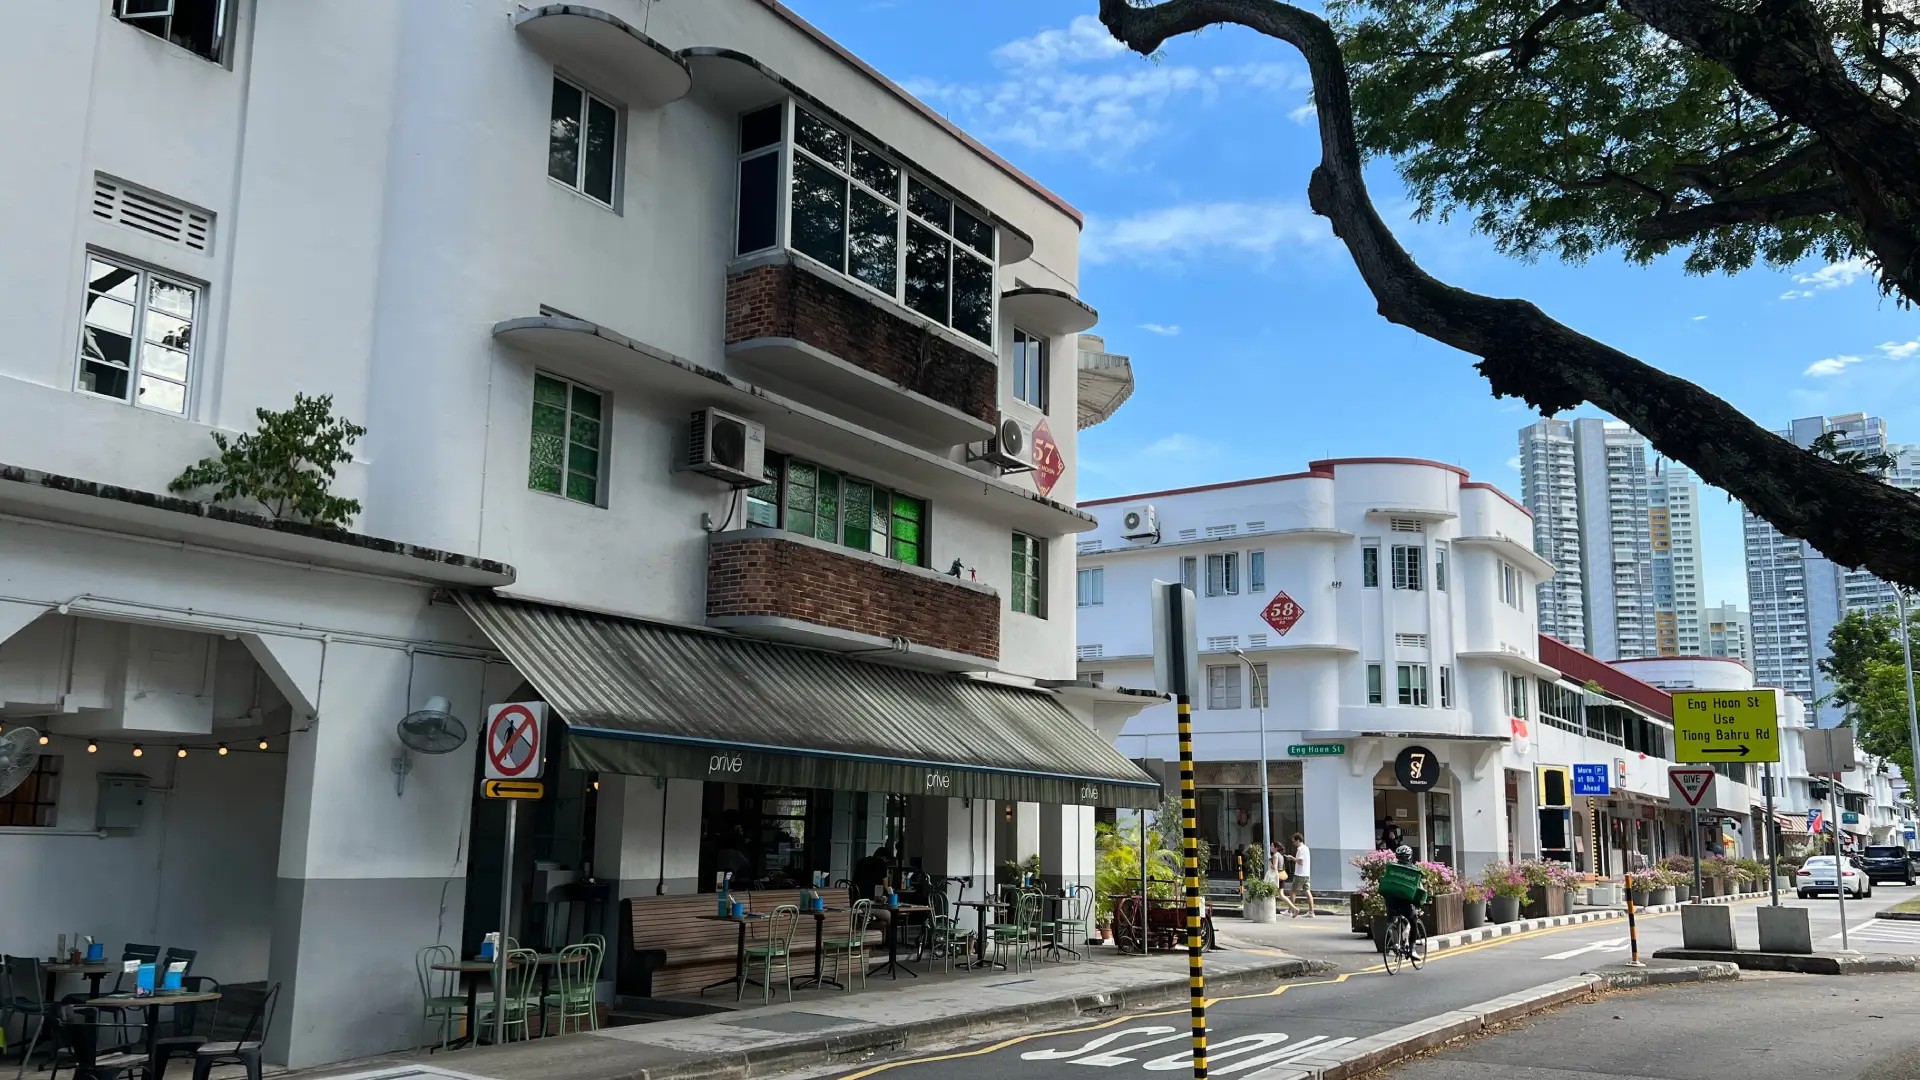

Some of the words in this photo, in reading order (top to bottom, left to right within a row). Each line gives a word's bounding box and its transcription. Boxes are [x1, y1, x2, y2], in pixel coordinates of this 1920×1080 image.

[1033, 438, 1055, 465] 57
[1270, 602, 1294, 616] 58
[1688, 698, 1707, 712] Eng
[1713, 697, 1741, 709] Hoon
[1747, 696, 1760, 708] St
[1713, 713, 1735, 725] Use
[1682, 729, 1710, 743] Tiong
[1716, 729, 1750, 741] Bahru
[1756, 728, 1770, 740] Rd
[1291, 746, 1306, 755] Eng
[1308, 745, 1330, 754] Hoon
[1332, 745, 1341, 753] St
[708, 751, 743, 775] privé
[1577, 766, 1592, 774] More
[926, 770, 950, 790] privé
[1683, 774, 1701, 784] GIVE
[1081, 784, 1099, 801] privé
[1583, 784, 1601, 792] Ahead
